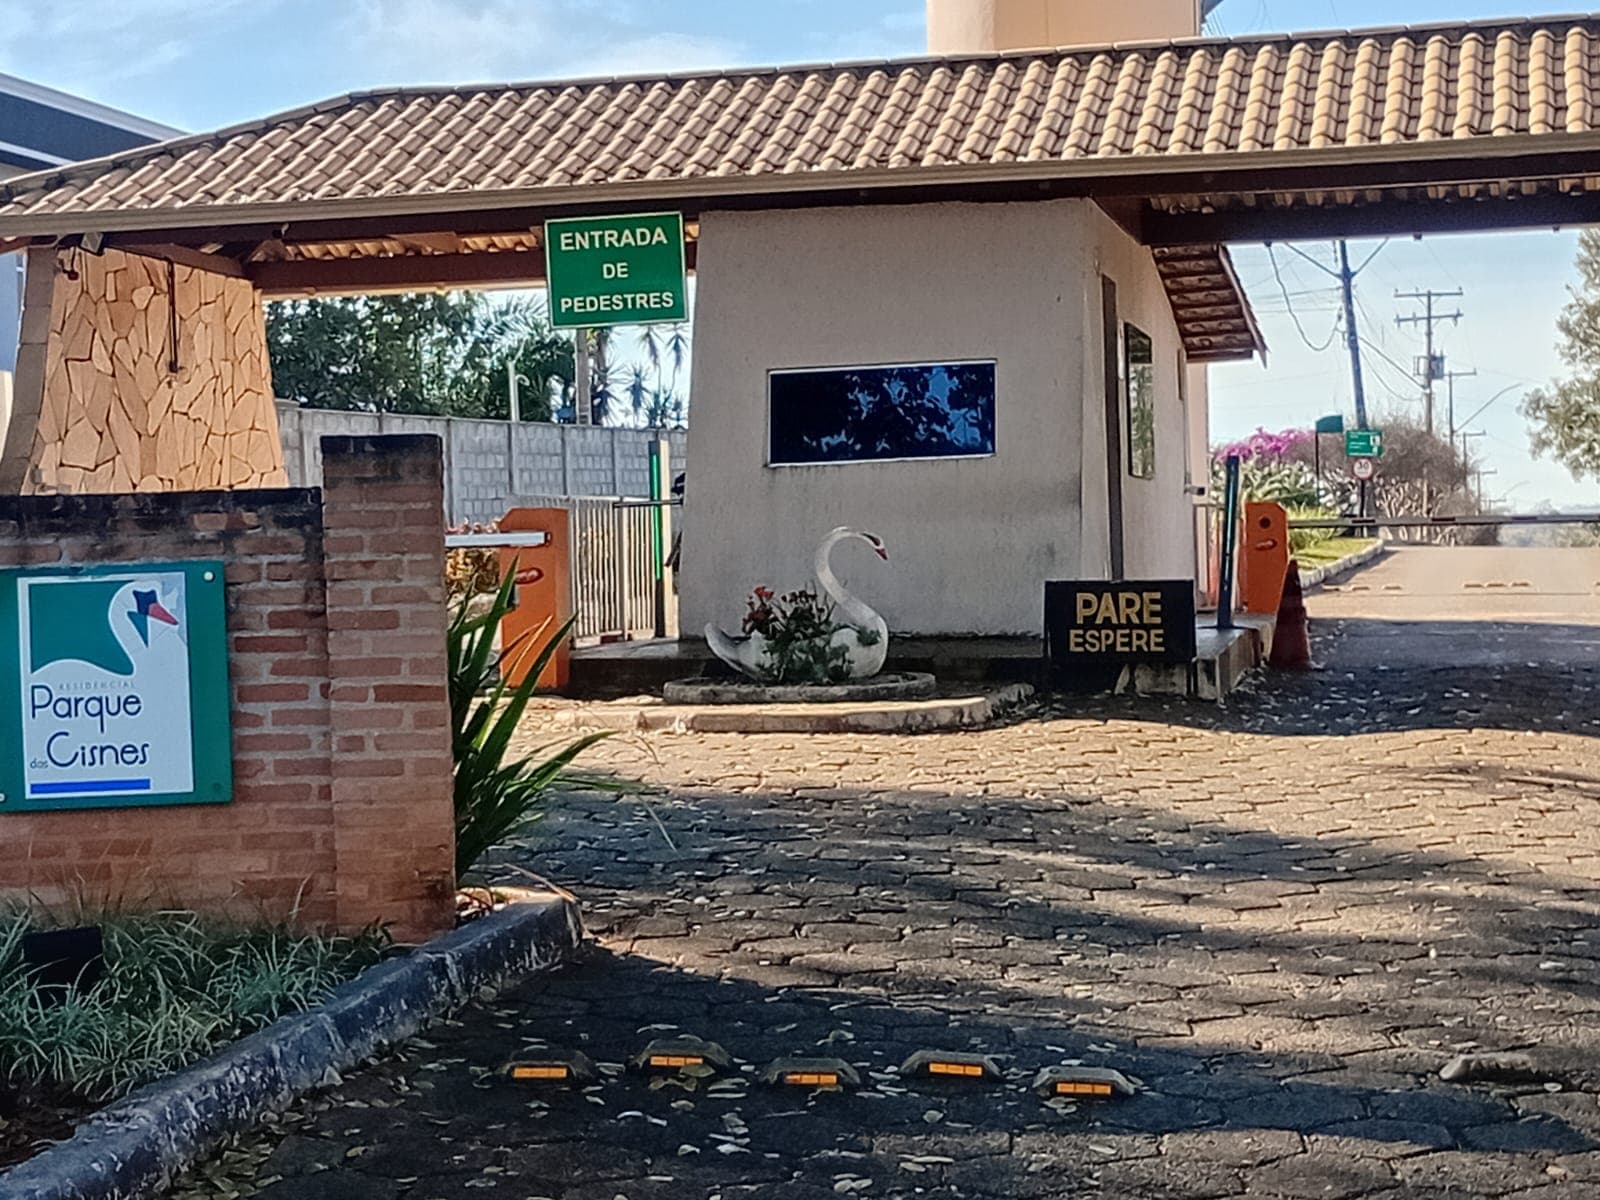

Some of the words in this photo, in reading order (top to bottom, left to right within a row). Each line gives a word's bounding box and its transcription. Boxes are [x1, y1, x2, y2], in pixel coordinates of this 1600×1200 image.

[560, 227, 668, 251] ENTRADA
[602, 262, 629, 279] DE
[560, 292, 674, 313] PEDESTRES
[1076, 591, 1162, 624] PARE
[1069, 629, 1165, 652] ESPERE
[31, 684, 142, 734] Parque
[46, 731, 150, 768] Cisnes
